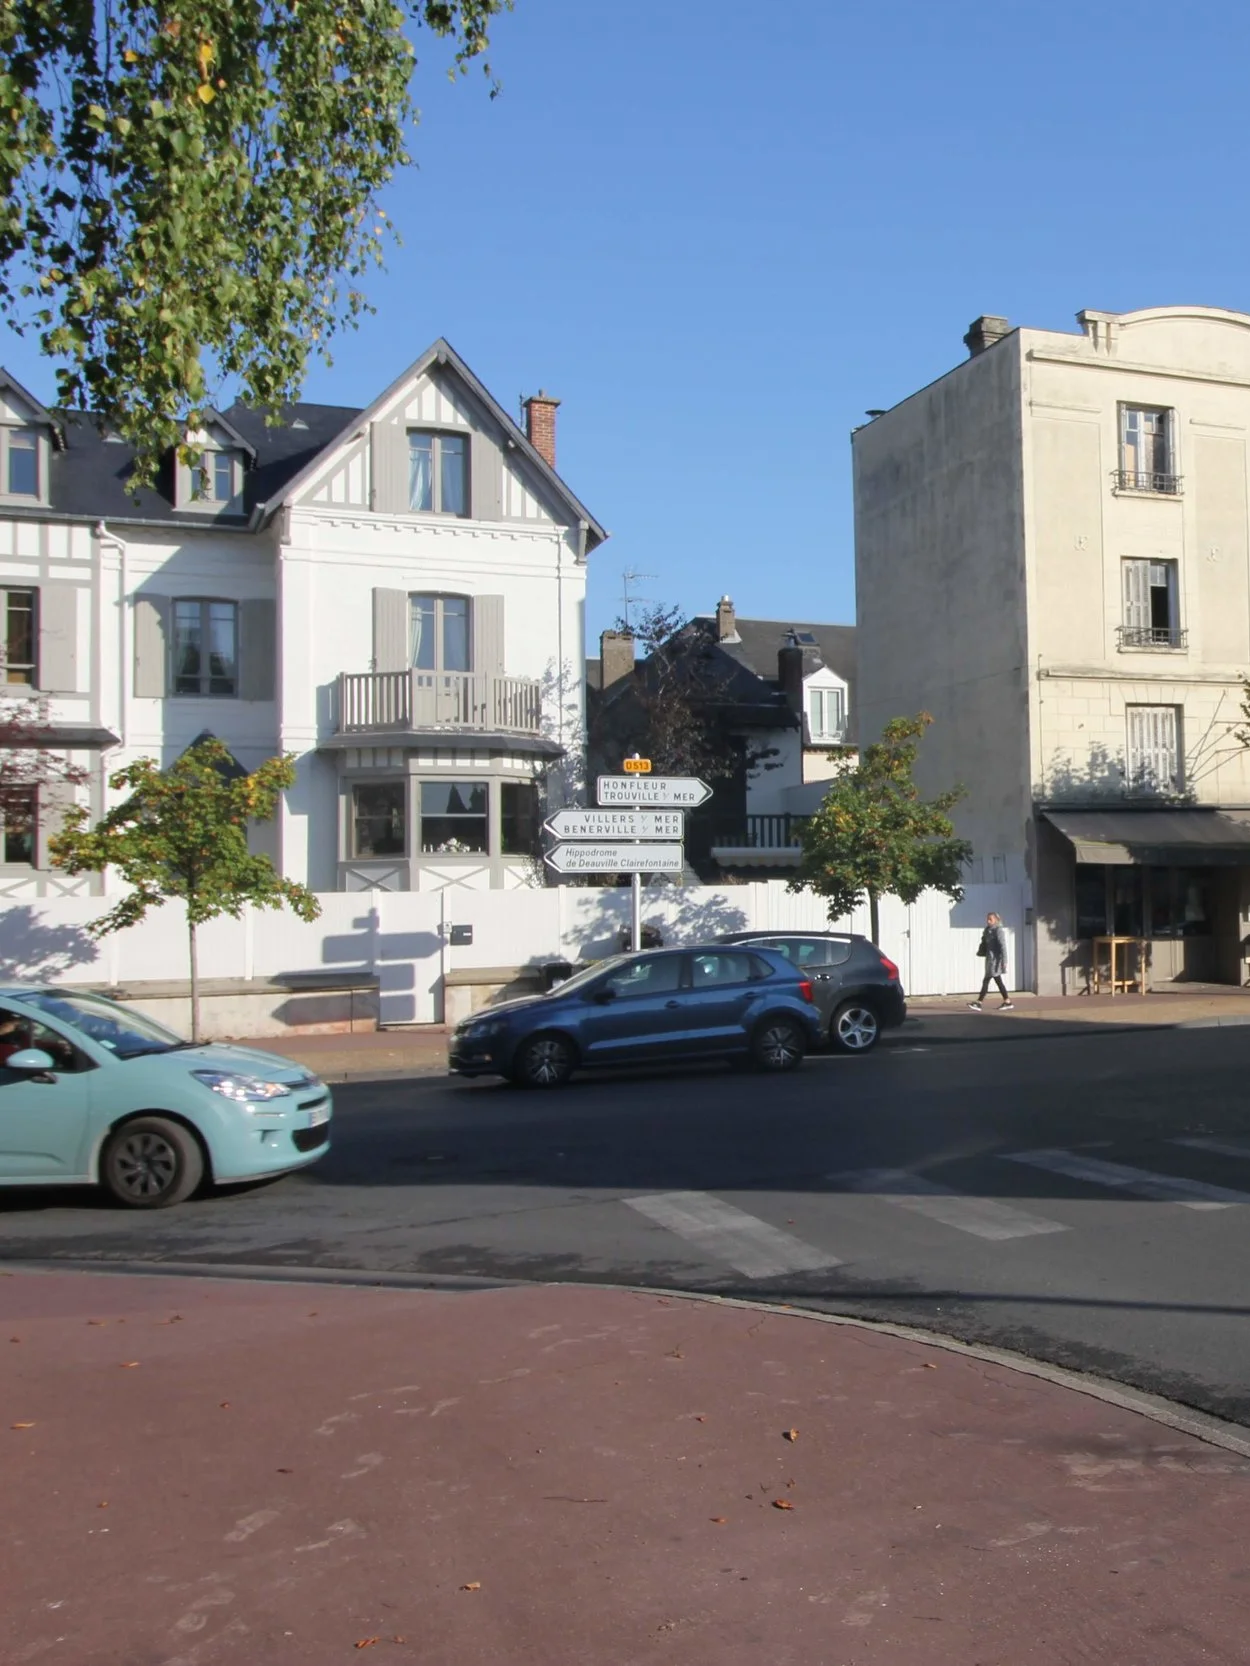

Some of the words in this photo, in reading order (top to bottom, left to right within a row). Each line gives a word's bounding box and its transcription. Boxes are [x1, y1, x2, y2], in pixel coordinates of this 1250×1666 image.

[603, 781, 667, 790] HONFLEUR
[604, 791, 659, 801] TROUVILLE
[673, 792, 695, 801] MER
[584, 815, 634, 823] VILLERS
[654, 815, 679, 823] MER
[564, 825, 636, 834] BENERVILLE
[655, 825, 679, 834] MER
[565, 848, 618, 858] Hippodrome
[566, 859, 577, 868] de
[578, 859, 618, 868] Deauville
[620, 859, 680, 868] Clairefontaine
